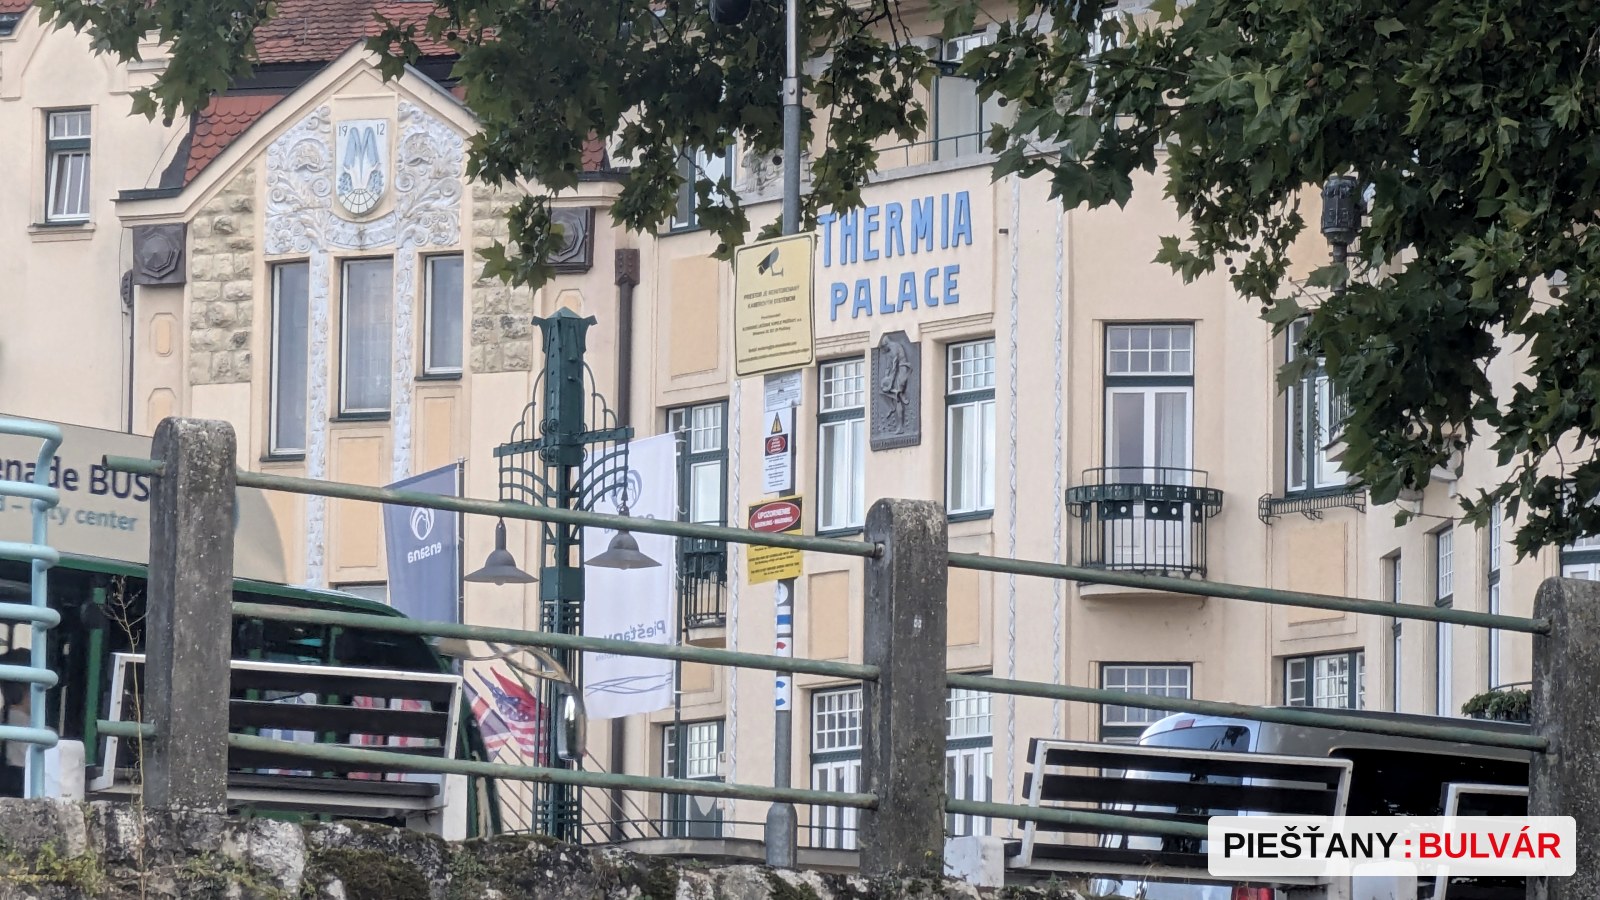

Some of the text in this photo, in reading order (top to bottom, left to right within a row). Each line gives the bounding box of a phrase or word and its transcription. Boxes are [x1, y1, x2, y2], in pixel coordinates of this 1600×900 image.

[817, 190, 973, 268] THERMIA
[830, 264, 960, 322] PALACE
[0, 455, 150, 502] nade BUS
[75, 509, 138, 532] center
